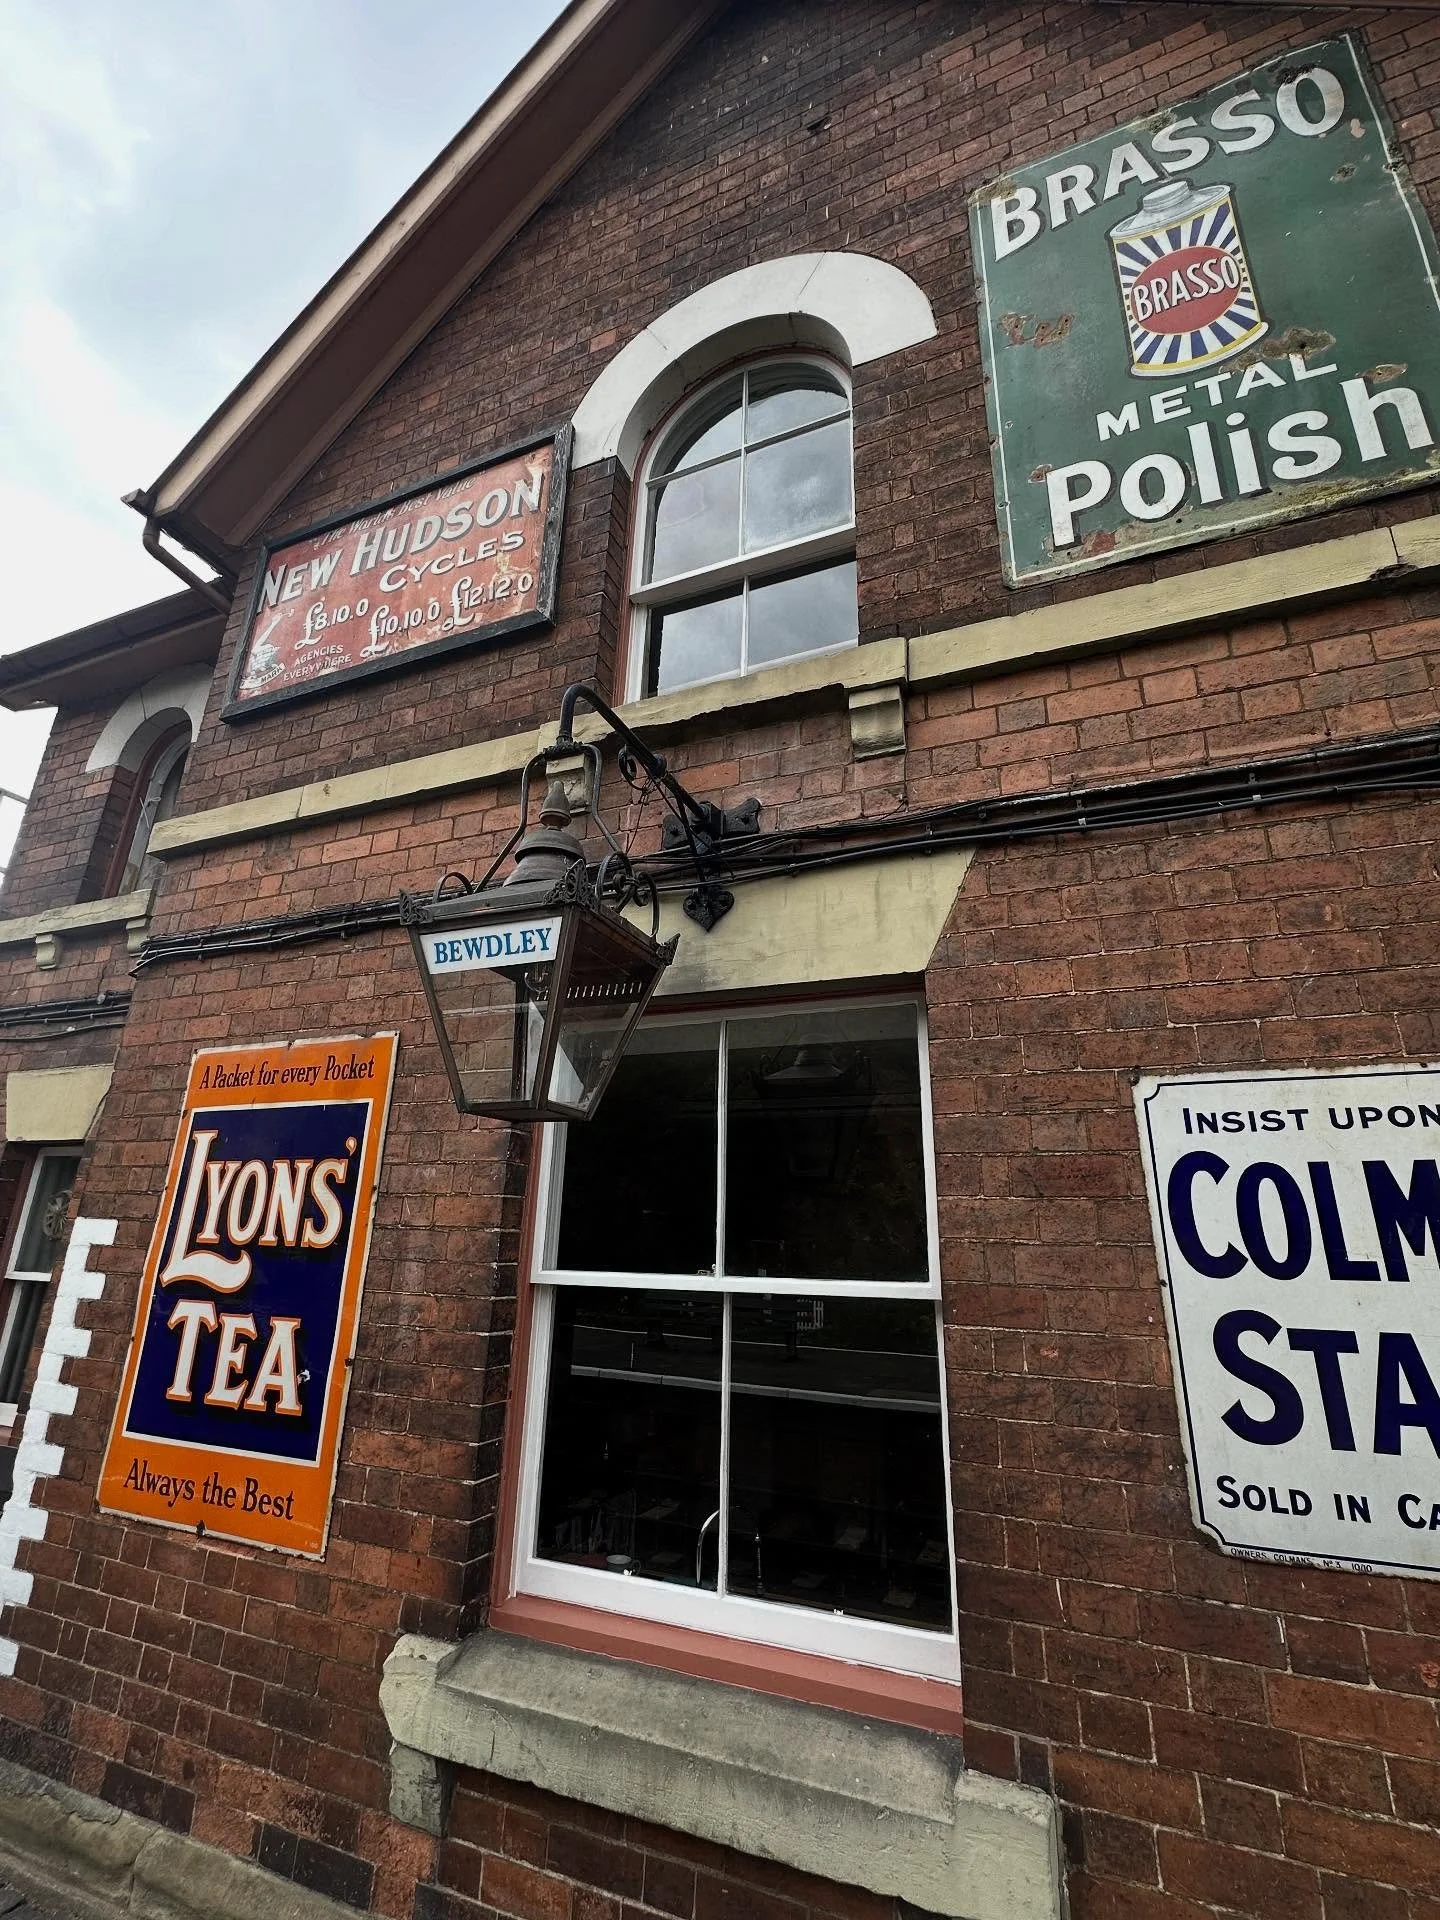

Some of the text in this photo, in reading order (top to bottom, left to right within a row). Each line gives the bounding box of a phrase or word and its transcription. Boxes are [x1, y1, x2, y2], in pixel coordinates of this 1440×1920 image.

[991, 66, 1346, 263] BRASSO
[1133, 255, 1240, 322] BRASSO
[1097, 353, 1338, 441] METAL
[1046, 378, 1434, 547] Polish
[397, 494, 431, 517] Best
[256, 471, 543, 615] NEW HUDSON
[379, 529, 525, 592] CYCLES
[283, 653, 352, 681] EVERYWHERE
[293, 644, 345, 667] AGENCIES
[434, 928, 551, 964] BEWDLEY
[199, 1053, 376, 1089] A Packet for every Pocket
[1183, 1105, 1440, 1134] INSIST UPON
[160, 1128, 358, 1294] LYONS'
[166, 1299, 303, 1416] TEA
[123, 1457, 295, 1520] Always the Best
[1217, 1474, 1313, 1517] SOLD
[1335, 1493, 1372, 1524] IN
[1230, 1547, 1267, 1560] OWNERS
